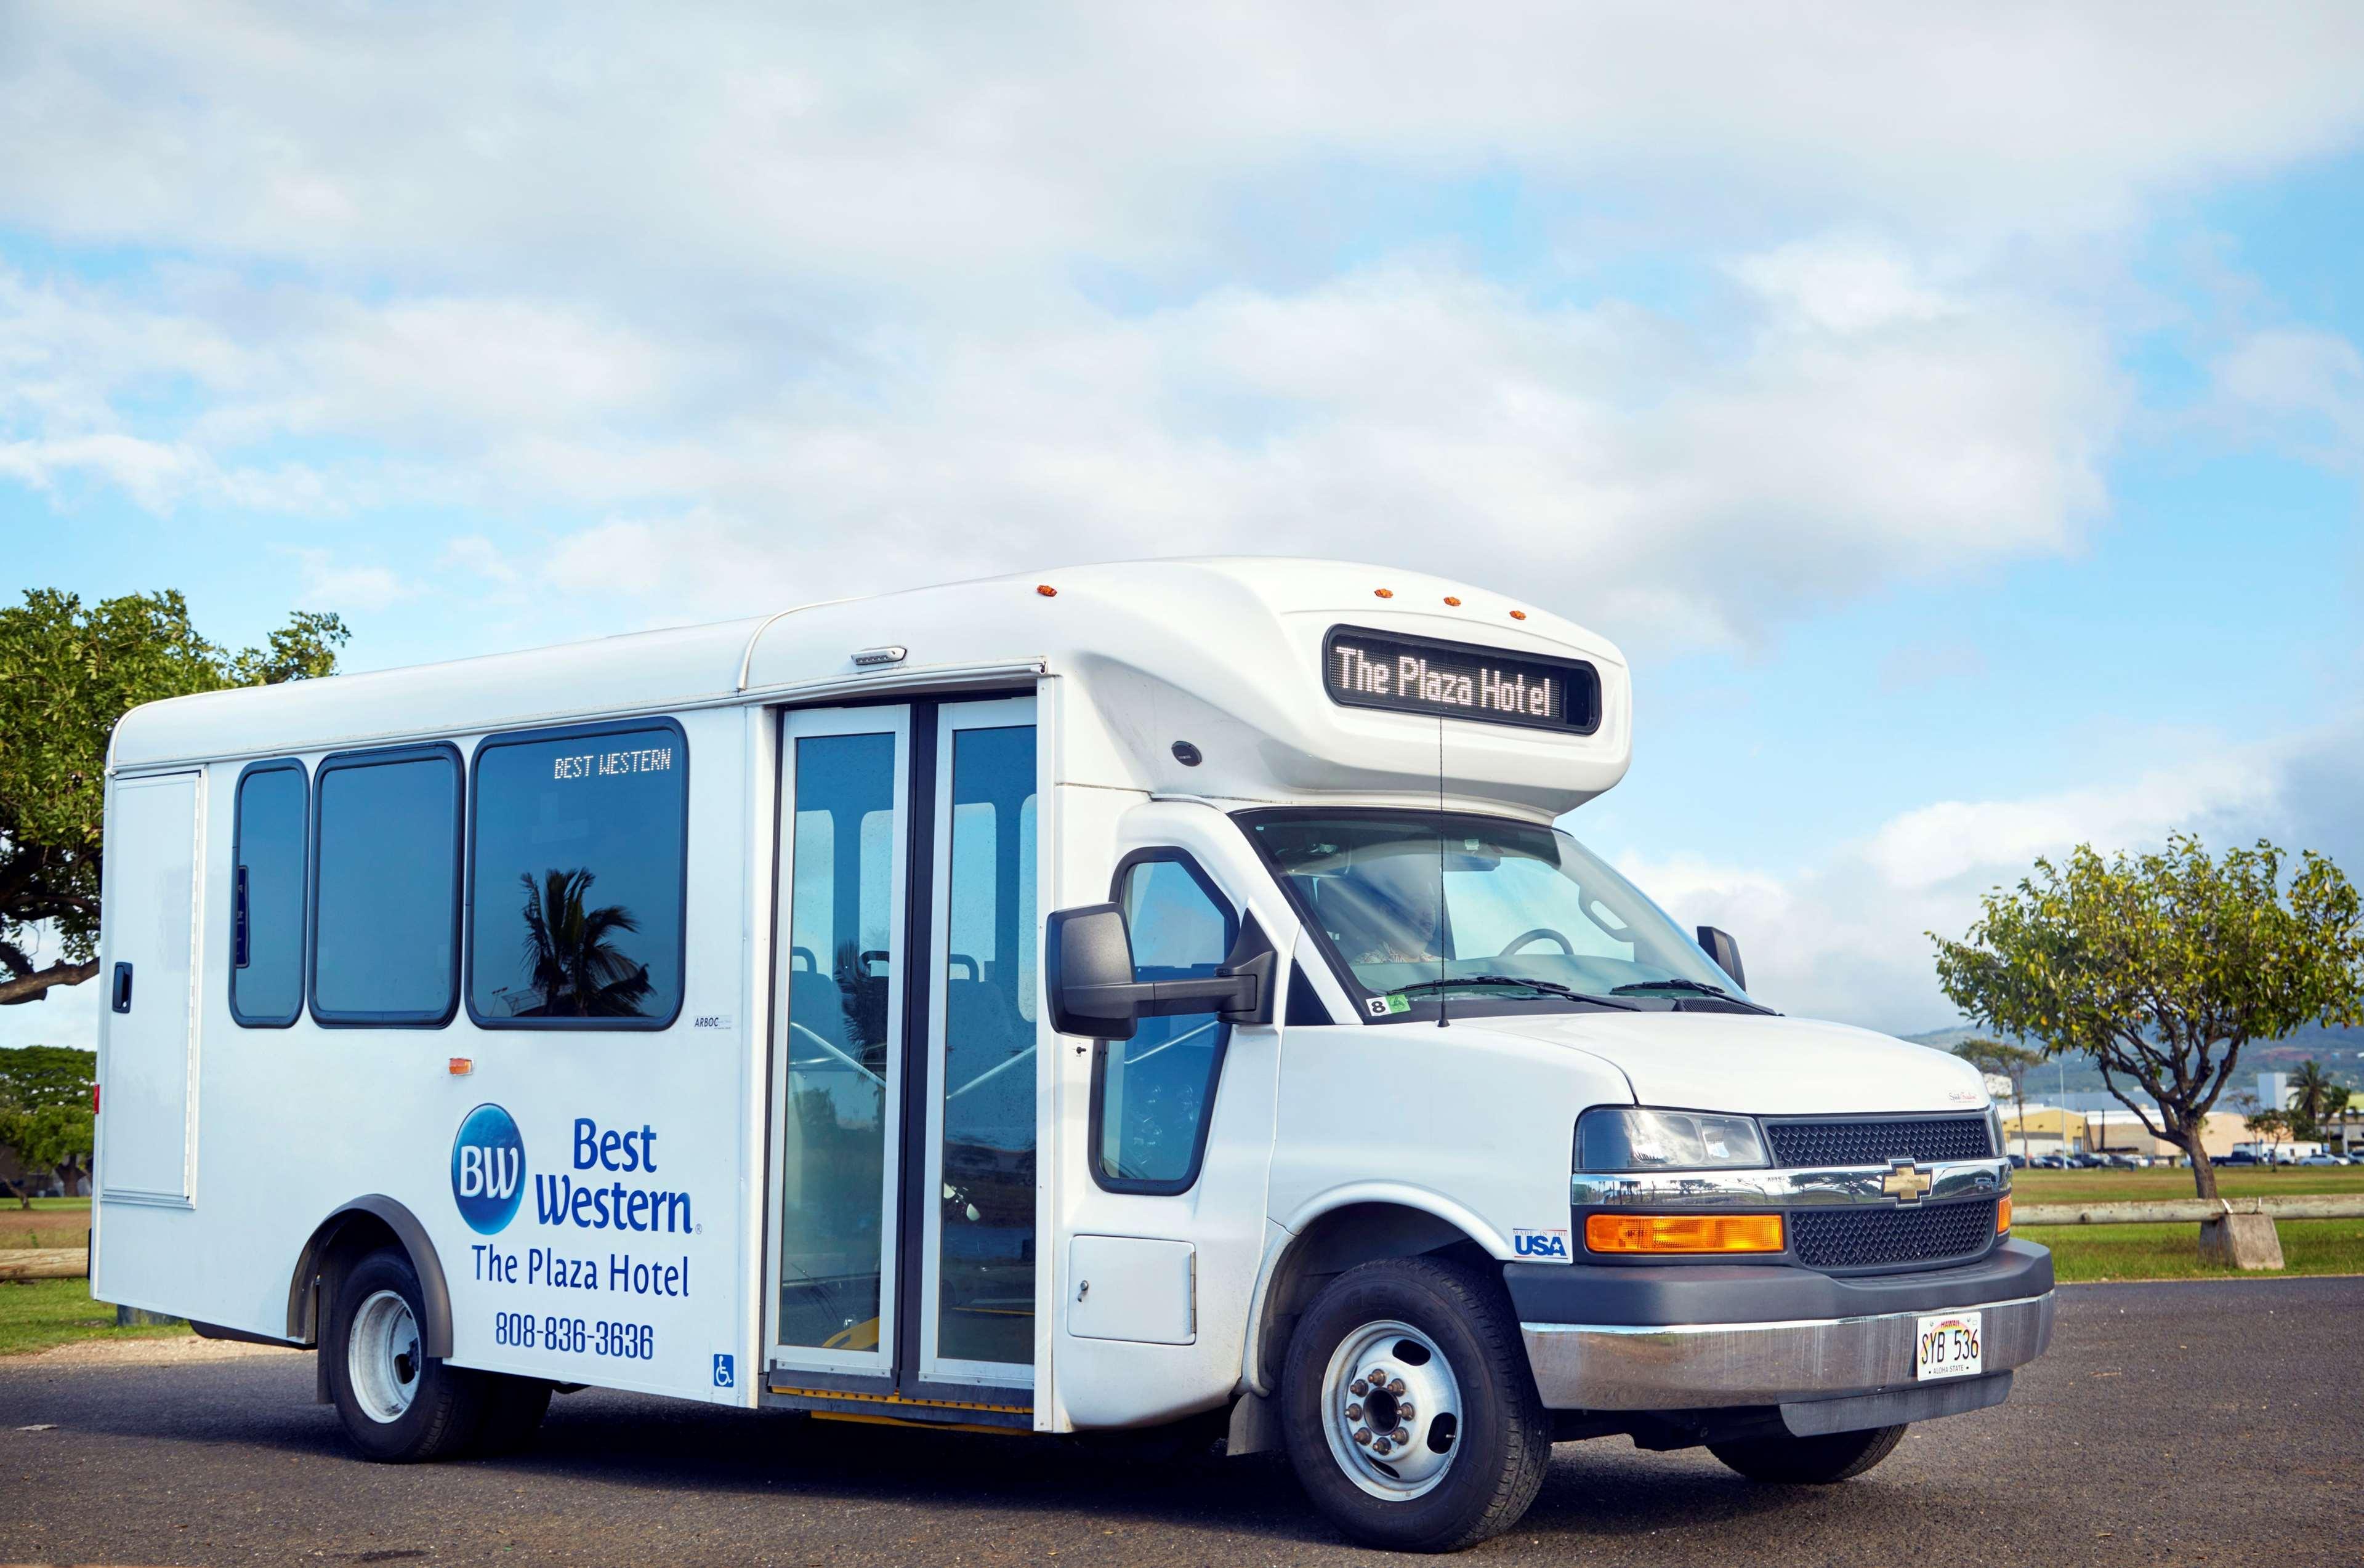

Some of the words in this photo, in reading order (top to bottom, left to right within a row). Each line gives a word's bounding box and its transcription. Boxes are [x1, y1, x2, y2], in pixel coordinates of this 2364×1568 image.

[1336, 646, 1390, 694] The
[1398, 656, 1472, 706] Plaza
[1480, 668, 1551, 717] Hotel
[554, 755, 594, 779] BEST
[599, 748, 671, 775] WESTERN
[695, 1018, 719, 1027] ARBOC
[1371, 1000, 1386, 1013] 8
[573, 1117, 657, 1173] Best
[459, 1145, 518, 1200] BW
[1515, 1235, 1567, 1256] USA
[471, 1244, 518, 1284] The
[528, 1247, 599, 1290] Plaza
[610, 1253, 690, 1297] Hotel
[496, 1312, 653, 1361] 808-836-3636
[1941, 1320, 1959, 1328] HAWAII
[1922, 1332, 1945, 1364] SYB
[1955, 1329, 1979, 1360] 536
